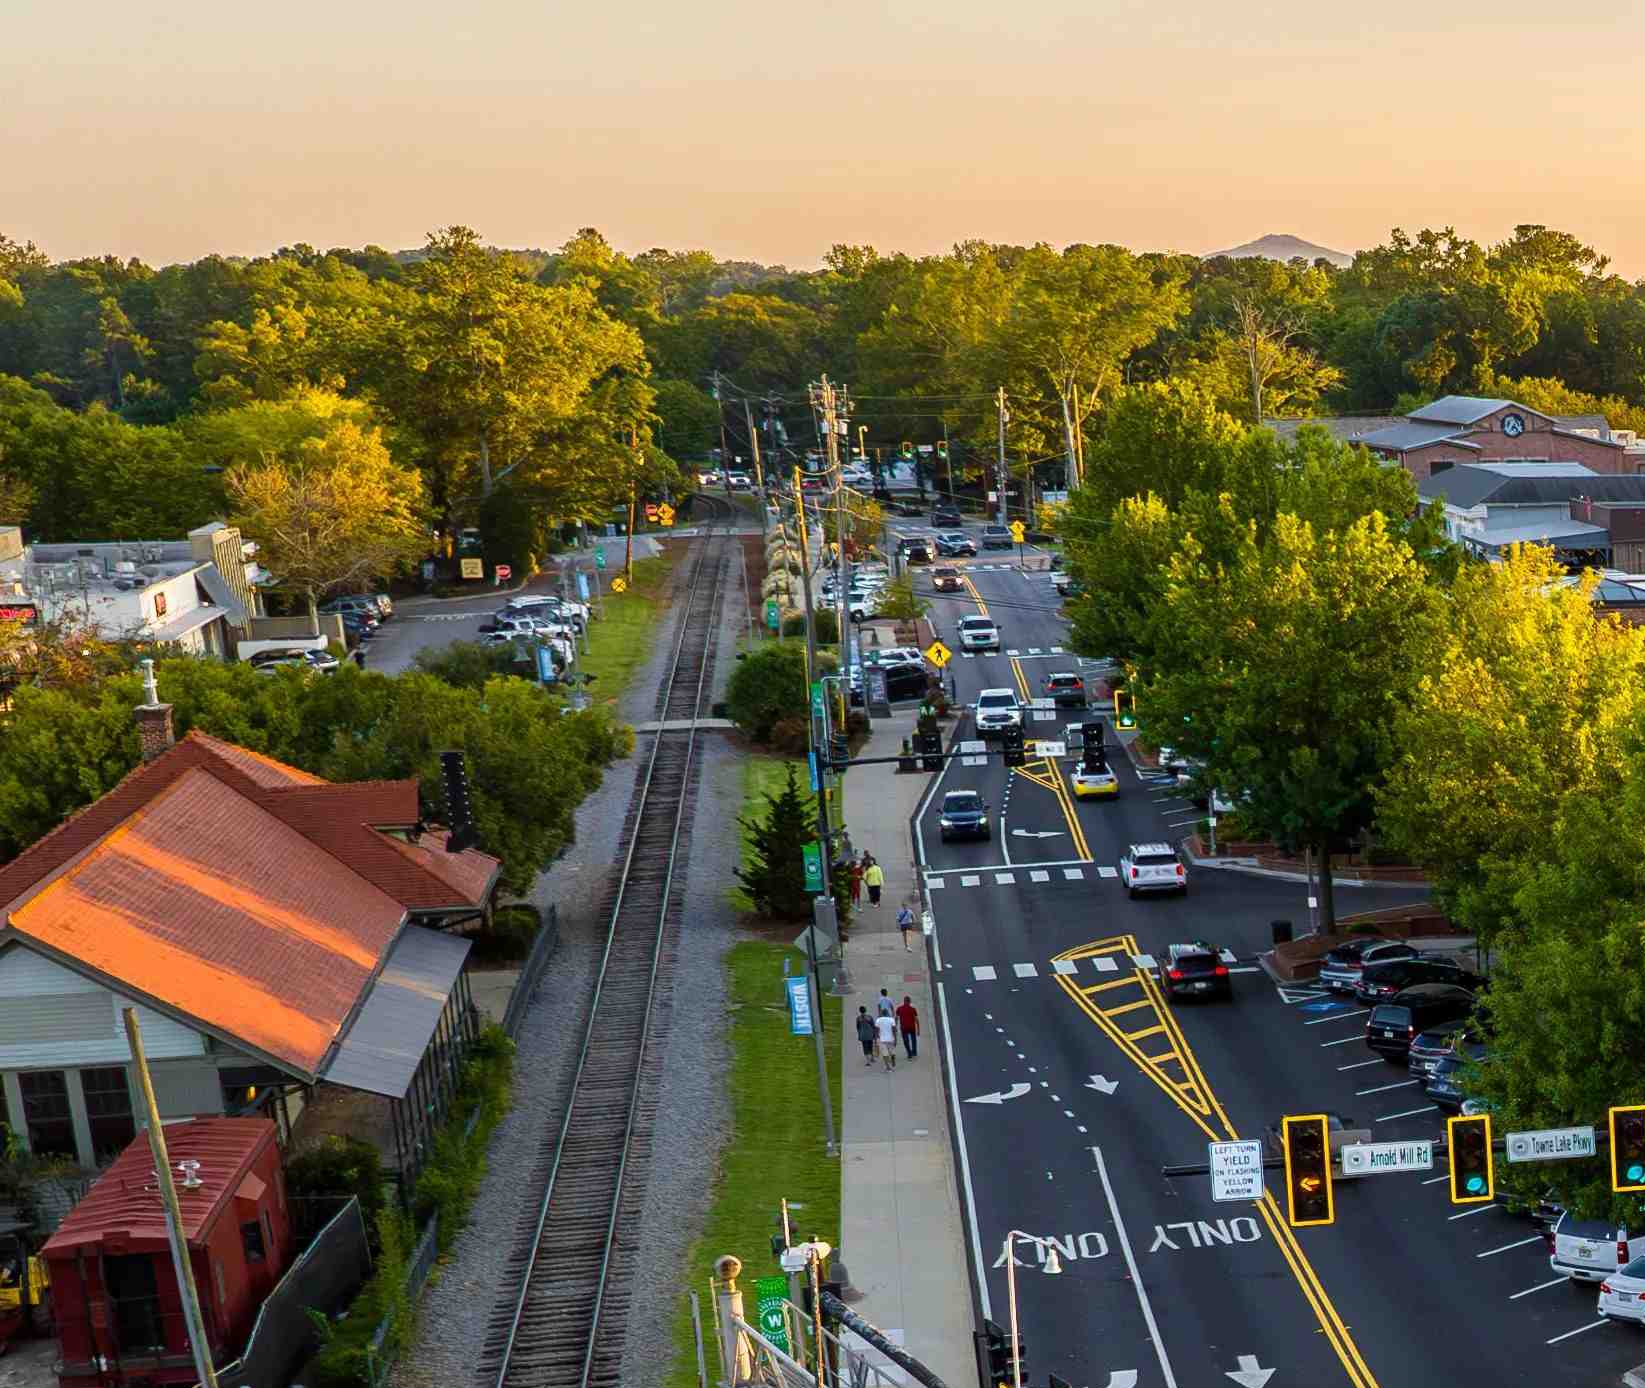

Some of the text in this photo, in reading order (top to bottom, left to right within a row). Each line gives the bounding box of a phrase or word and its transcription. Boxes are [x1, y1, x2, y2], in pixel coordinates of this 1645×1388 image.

[1215, 1145, 1257, 1154] LEFT TURN
[1531, 1134, 1592, 1154] Towne Lake Pkwy
[1223, 1155, 1250, 1166] YIELD
[1370, 1149, 1429, 1167] Arnold Mill Rd
[1228, 1168, 1260, 1176] FLASHING
[1224, 1178, 1254, 1186] YELLOW
[1150, 1216, 1262, 1253] ONLY
[992, 1232, 1110, 1269] ONLY
[767, 1314, 783, 1328] W
